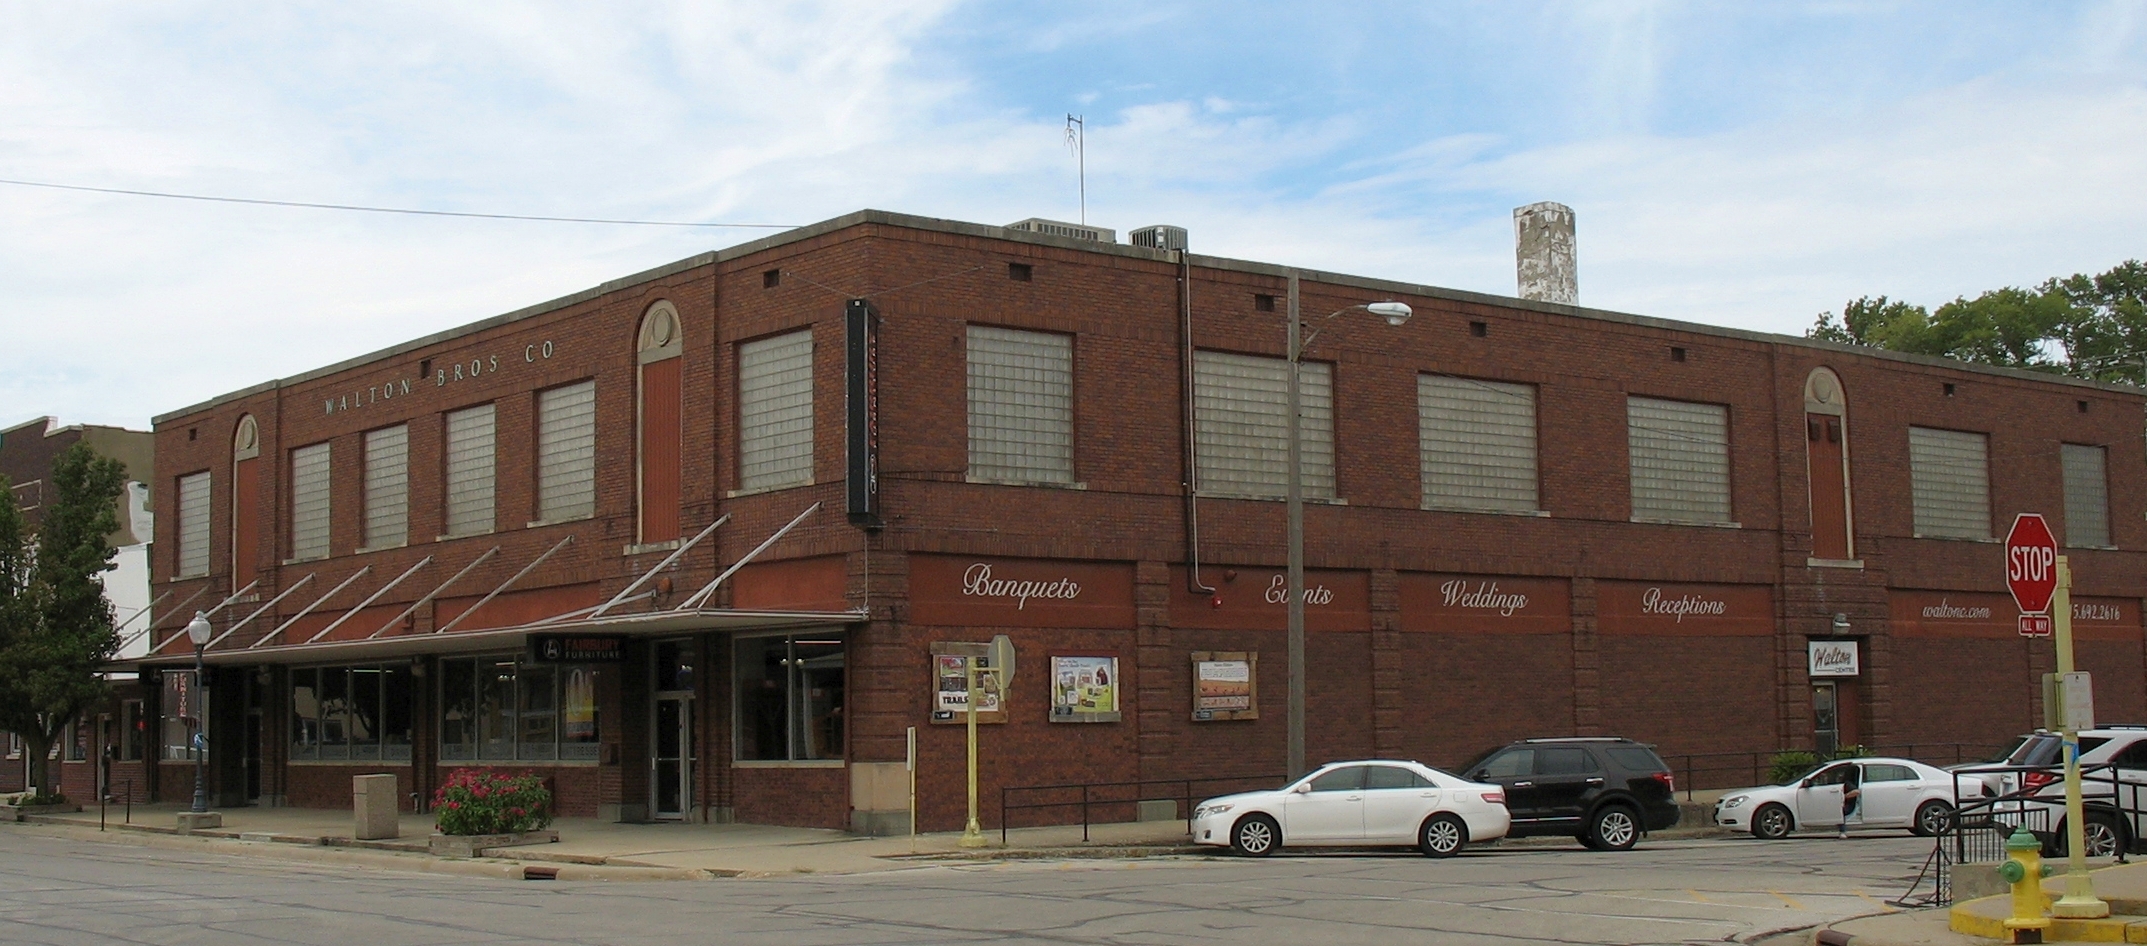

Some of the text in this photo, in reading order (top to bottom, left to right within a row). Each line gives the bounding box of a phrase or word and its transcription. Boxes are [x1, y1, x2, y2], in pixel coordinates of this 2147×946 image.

[325, 340, 553, 415] WALTON BROS CO
[2011, 545, 2053, 582] STOP
[962, 563, 1081, 610] Banquets
[1264, 574, 1334, 605] Evnts
[1440, 579, 1529, 617] Weddings
[1642, 587, 1727, 623] Receptions
[2069, 603, 2121, 621] 5.692.2616
[2021, 620, 2048, 631] ALL WAY
[564, 650, 621, 659] FURNITURE
